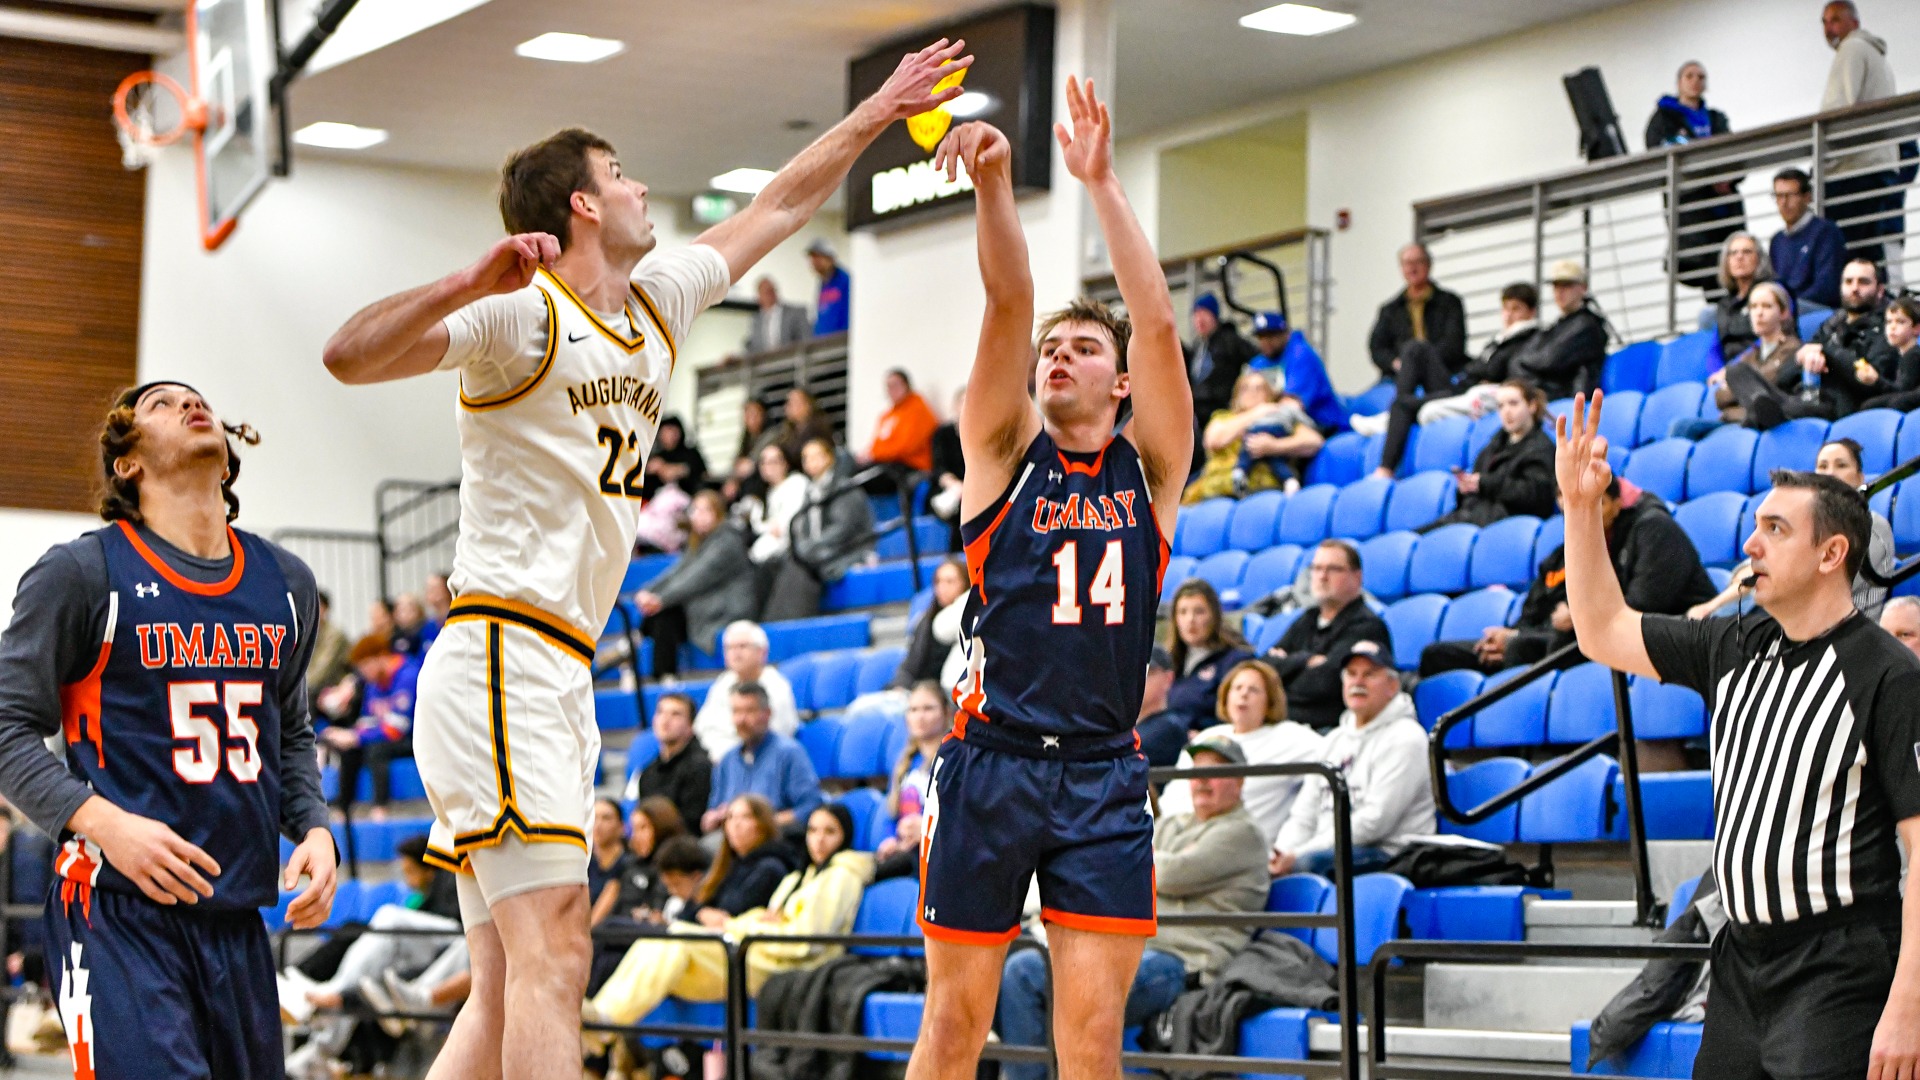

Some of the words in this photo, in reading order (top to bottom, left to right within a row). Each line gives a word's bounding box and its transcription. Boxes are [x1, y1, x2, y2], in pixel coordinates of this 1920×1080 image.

[567, 375, 662, 425] AUGUSTANA
[597, 424, 644, 500] 22
[1032, 489, 1137, 534] UMARY
[1051, 538, 1127, 626] 14
[136, 622, 287, 670] UMARY
[167, 680, 264, 785] 55
